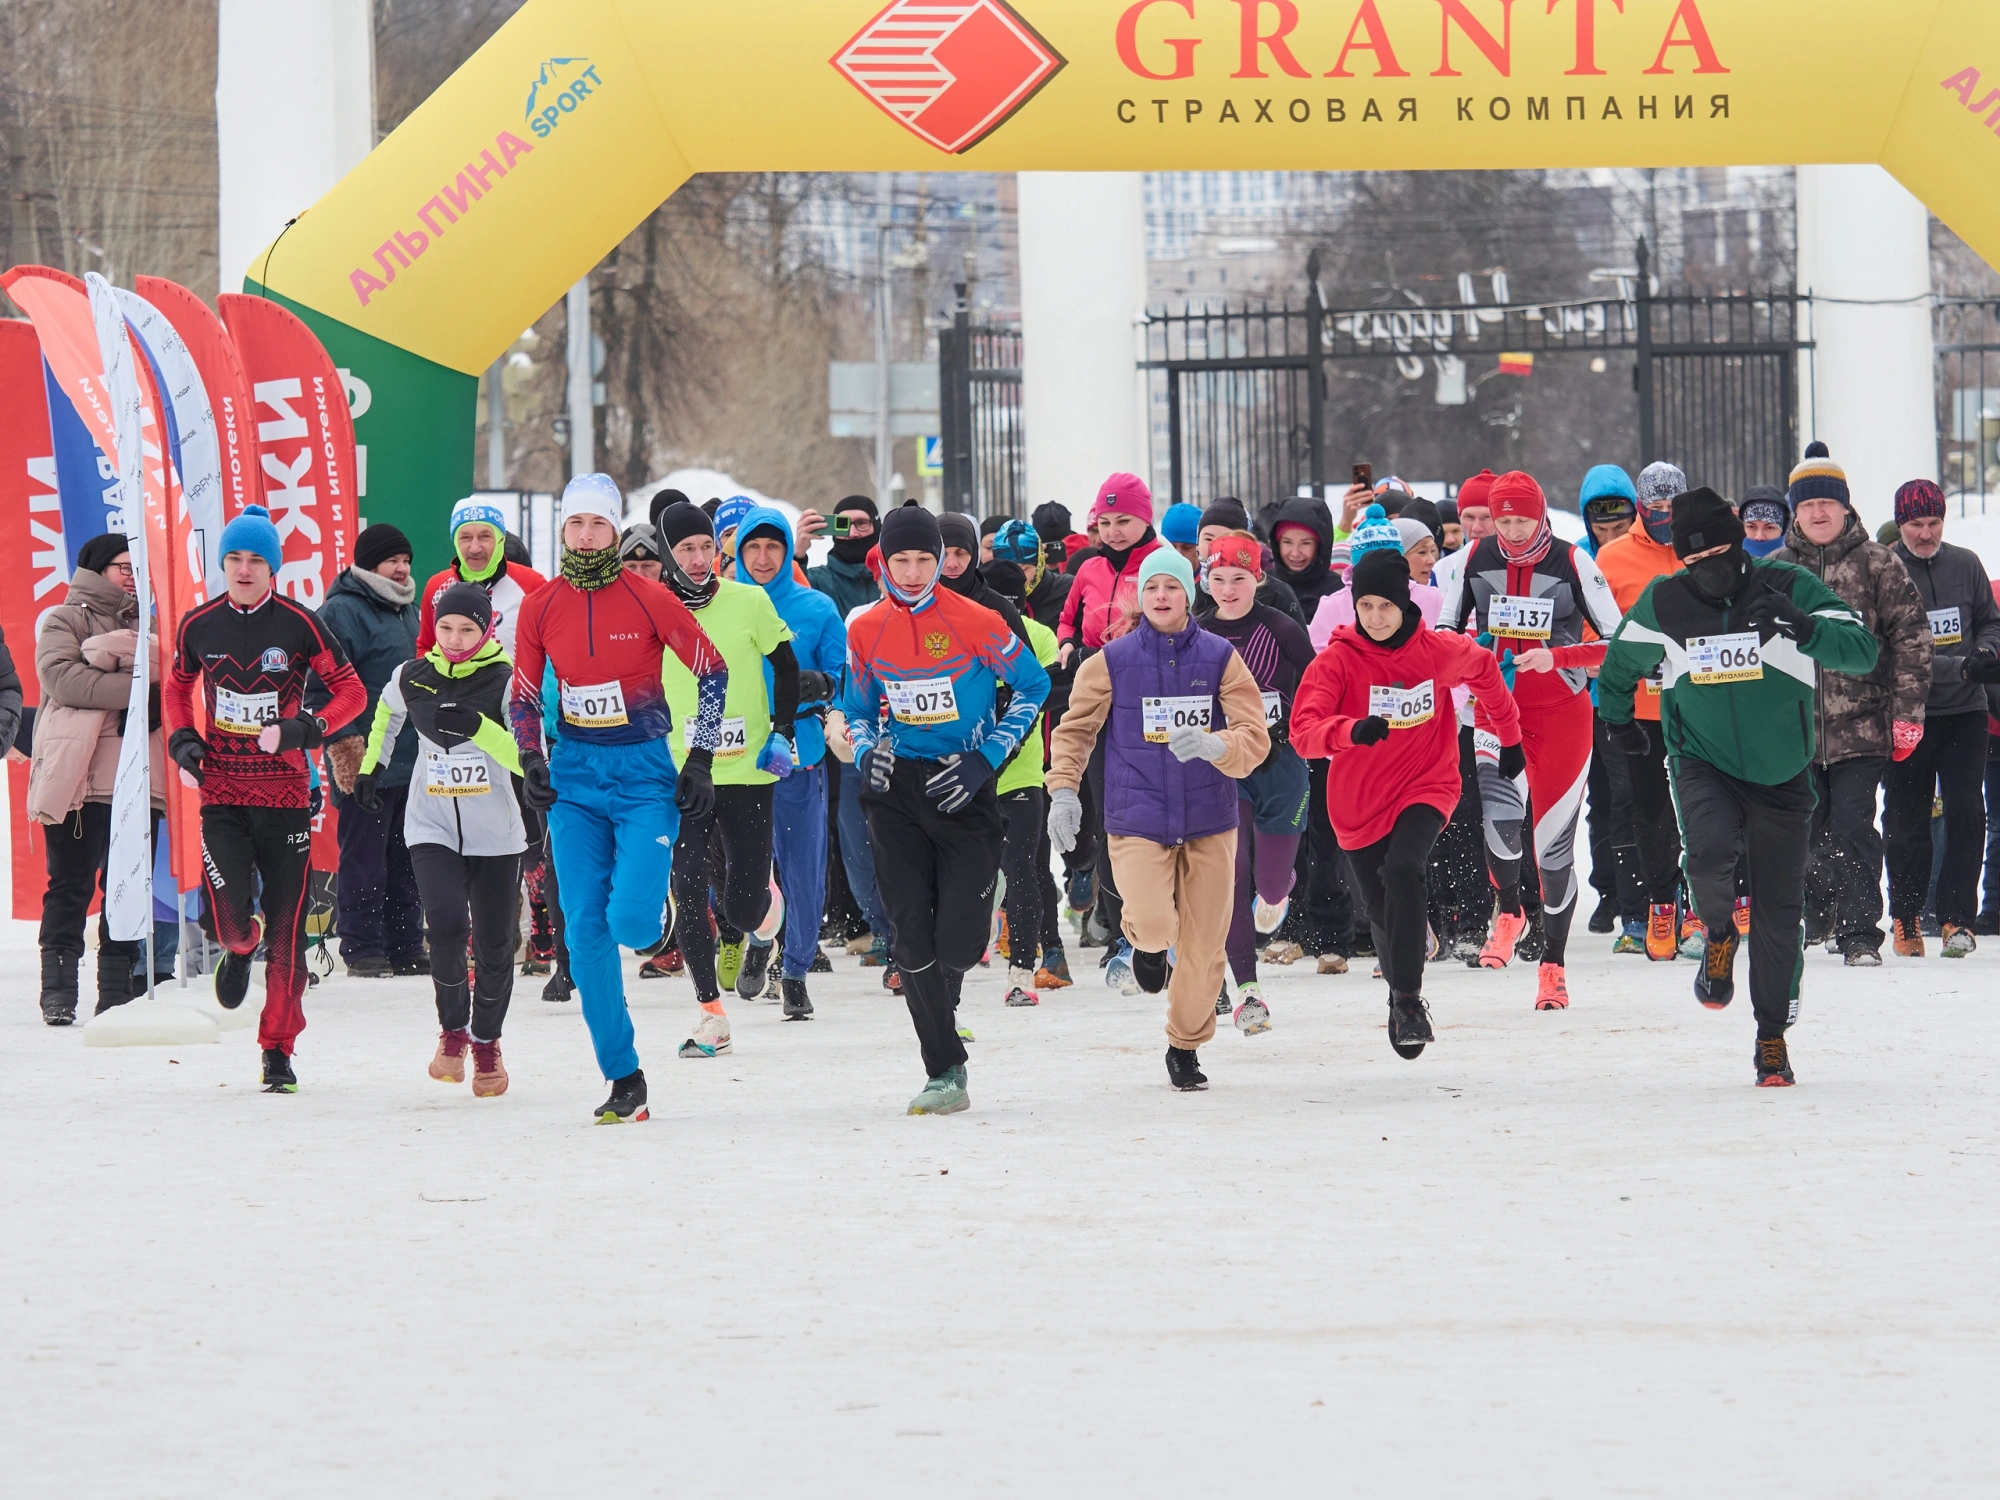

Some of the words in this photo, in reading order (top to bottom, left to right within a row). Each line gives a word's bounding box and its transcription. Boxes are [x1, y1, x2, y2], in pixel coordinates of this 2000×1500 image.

[1115, 0, 1730, 80] GRANTA
[530, 64, 602, 138] SPORT
[1117, 98, 1417, 123] СТРАХОВАЯ
[1457, 95, 1730, 121] КОМПАНИЯ
[349, 131, 535, 307] АЛЬПИНА
[312, 376, 342, 496] ипотеки
[222, 396, 243, 509] ипотеки
[1518, 610, 1551, 628] 137
[1934, 618, 1960, 635] 125
[609, 632, 639, 641] MOAX
[1490, 628, 1507, 636] клуб
[1720, 647, 1760, 669] 066
[1693, 673, 1711, 683] клуб
[585, 695, 623, 716] 071
[916, 691, 954, 712] 073
[1401, 693, 1433, 718] 065
[242, 704, 277, 723] 145
[1174, 708, 1210, 728] 063
[216, 720, 232, 730] клуб
[1146, 733, 1165, 742] клуб
[451, 765, 488, 784] 072
[429, 786, 445, 795] клуб
[1786, 1000, 1796, 1023] NIKE
